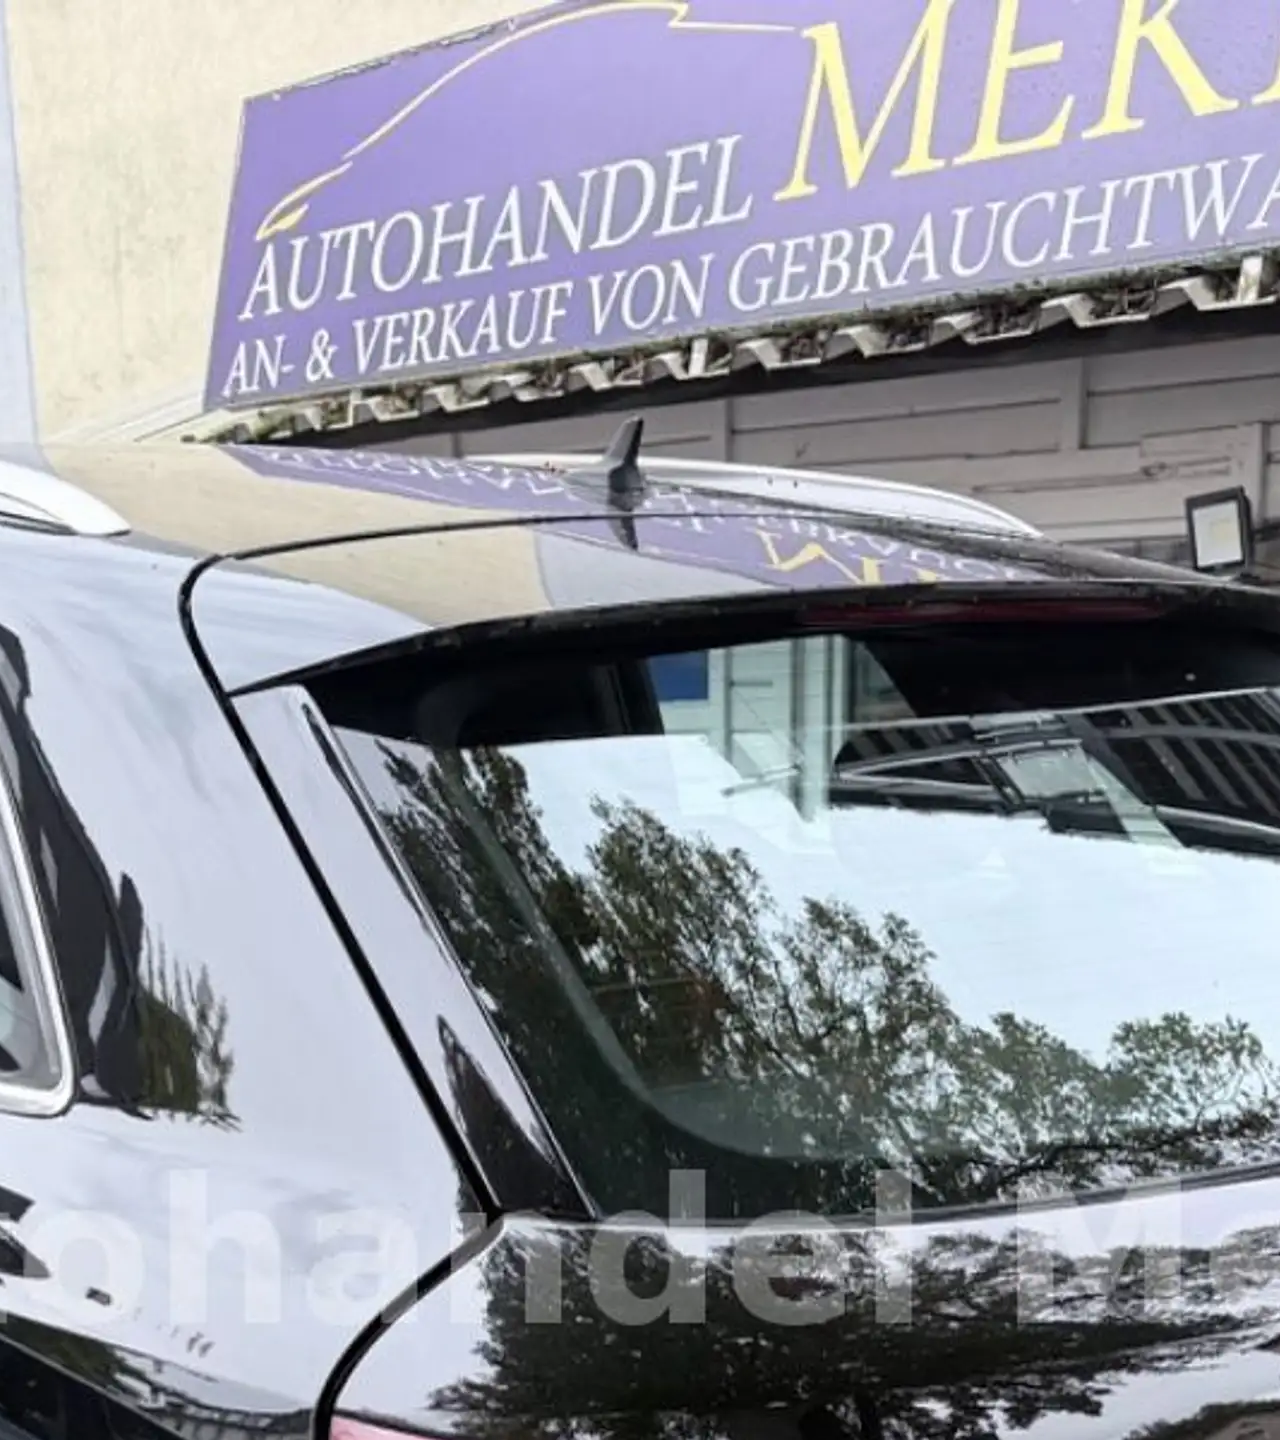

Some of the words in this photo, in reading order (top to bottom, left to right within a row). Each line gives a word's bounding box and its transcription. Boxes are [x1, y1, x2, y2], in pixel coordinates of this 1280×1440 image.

[237, 134, 754, 322] AUTOHANDEL
[220, 334, 294, 399] AN-
[305, 328, 337, 383] &
[352, 280, 574, 375] VERKAUF
[588, 253, 714, 337] VON
